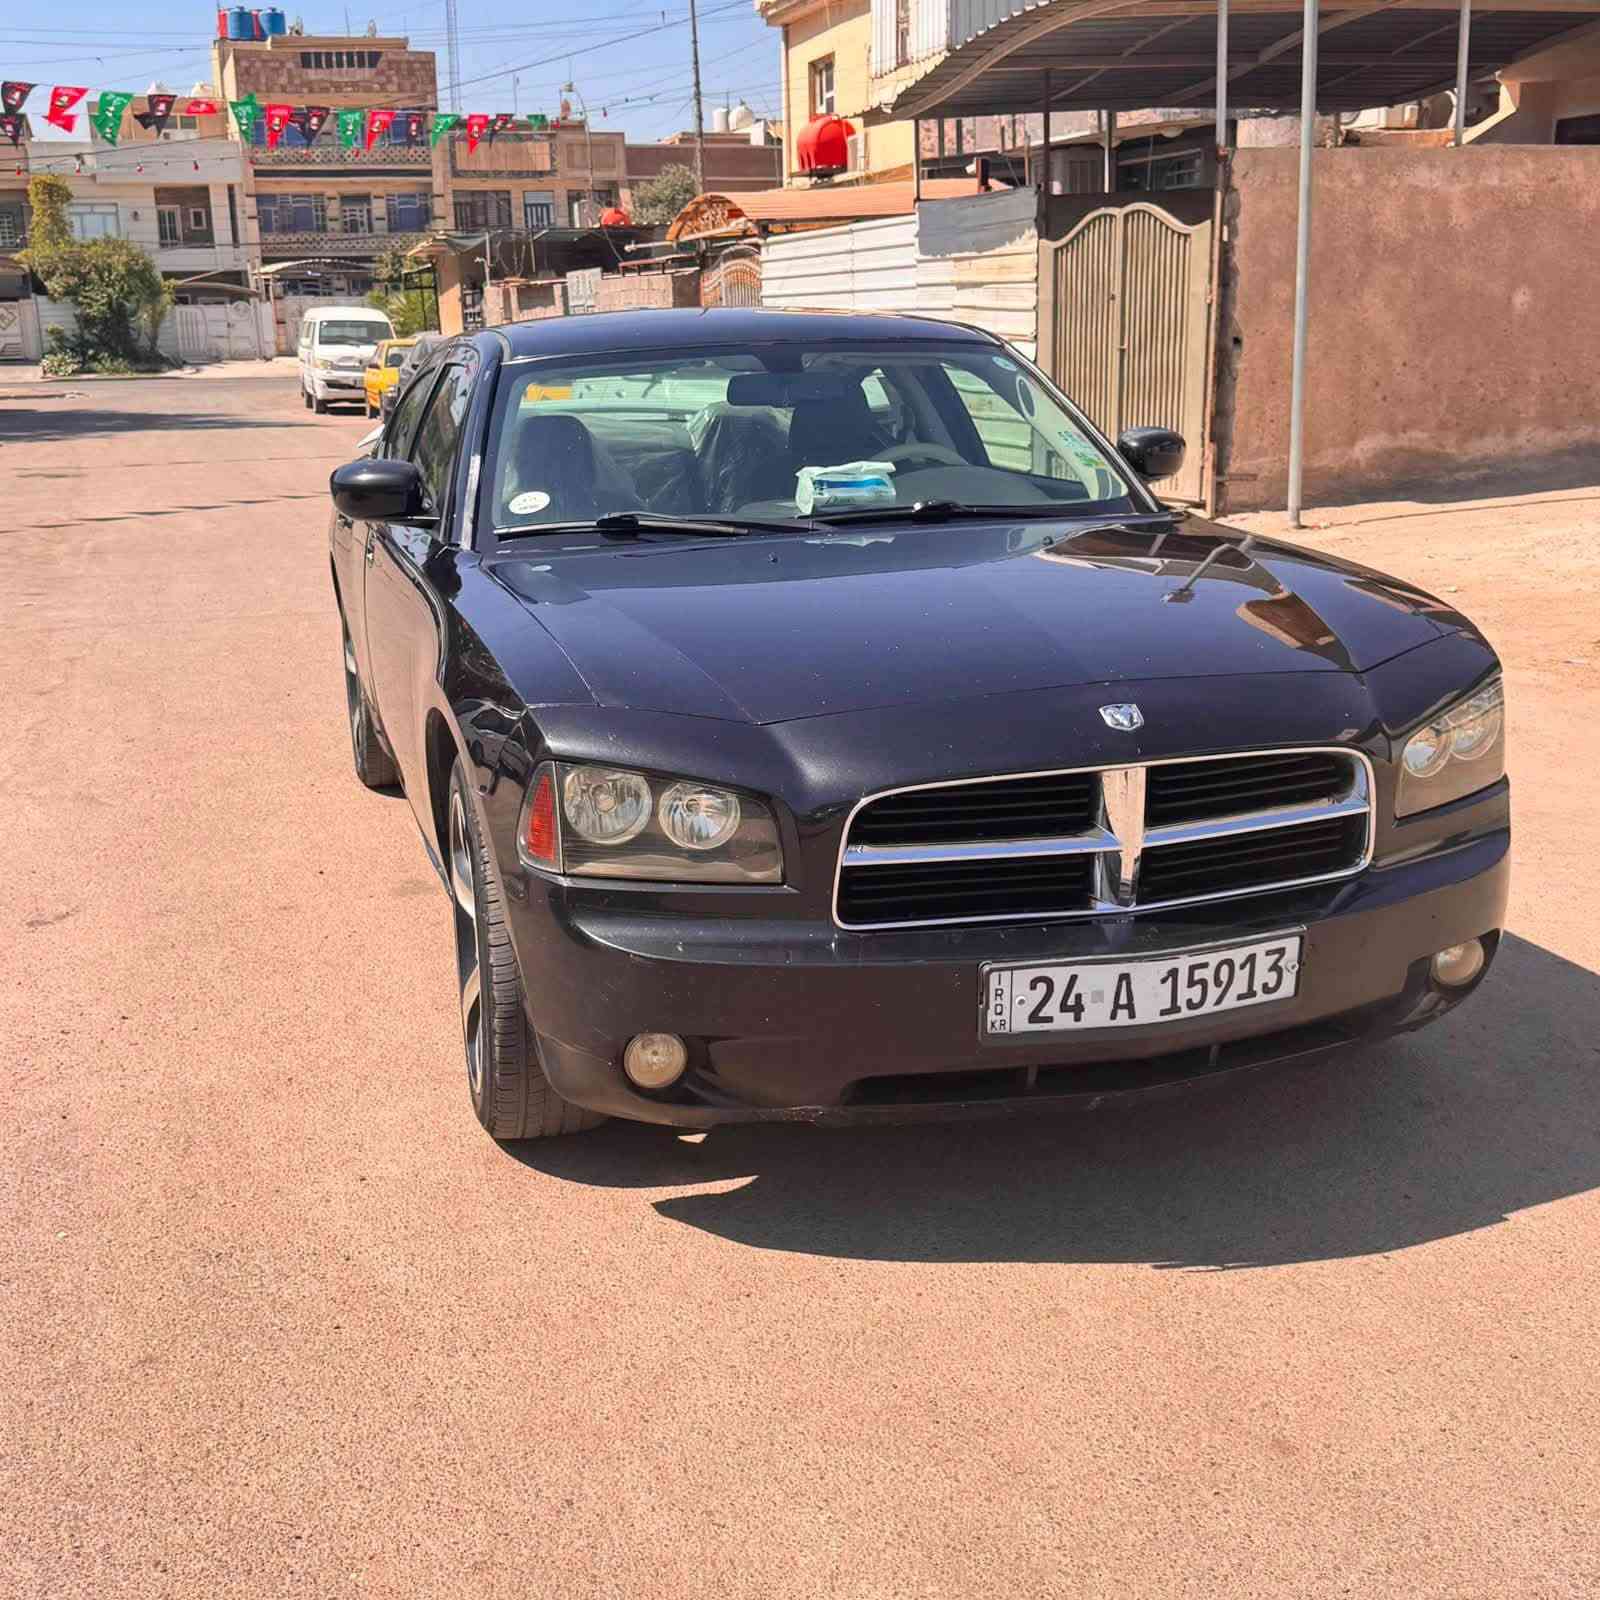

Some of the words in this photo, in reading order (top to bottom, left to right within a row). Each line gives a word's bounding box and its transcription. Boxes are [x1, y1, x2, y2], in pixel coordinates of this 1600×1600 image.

[1027, 974, 1085, 1024] 24
[1110, 972, 1137, 1021] A
[1158, 946, 1287, 1017] 15913
[991, 1019, 1007, 1031] KR
